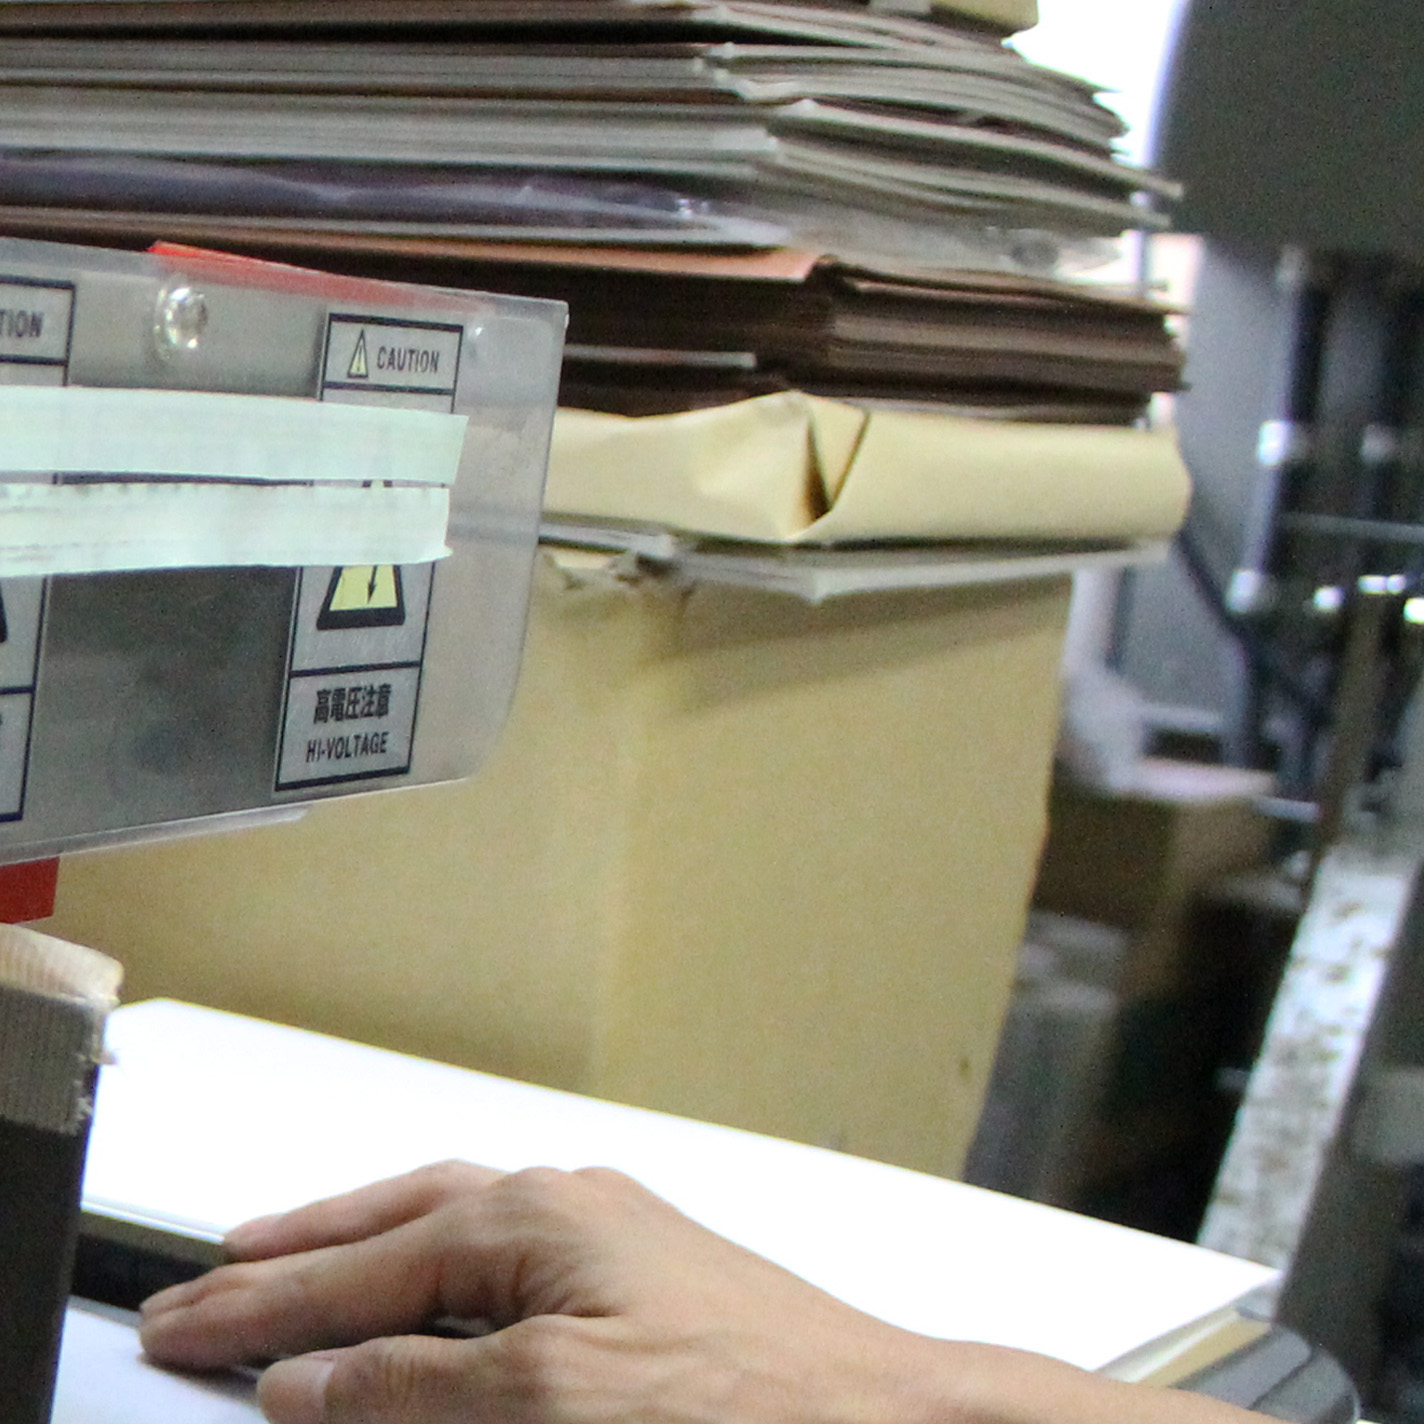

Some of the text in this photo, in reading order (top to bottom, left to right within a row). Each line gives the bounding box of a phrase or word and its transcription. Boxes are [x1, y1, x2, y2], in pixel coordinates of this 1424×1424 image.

[377, 345, 440, 374] CAUTION
[313, 683, 392, 725] 高電圧注意
[305, 731, 390, 763] HI-VOLTAGE
